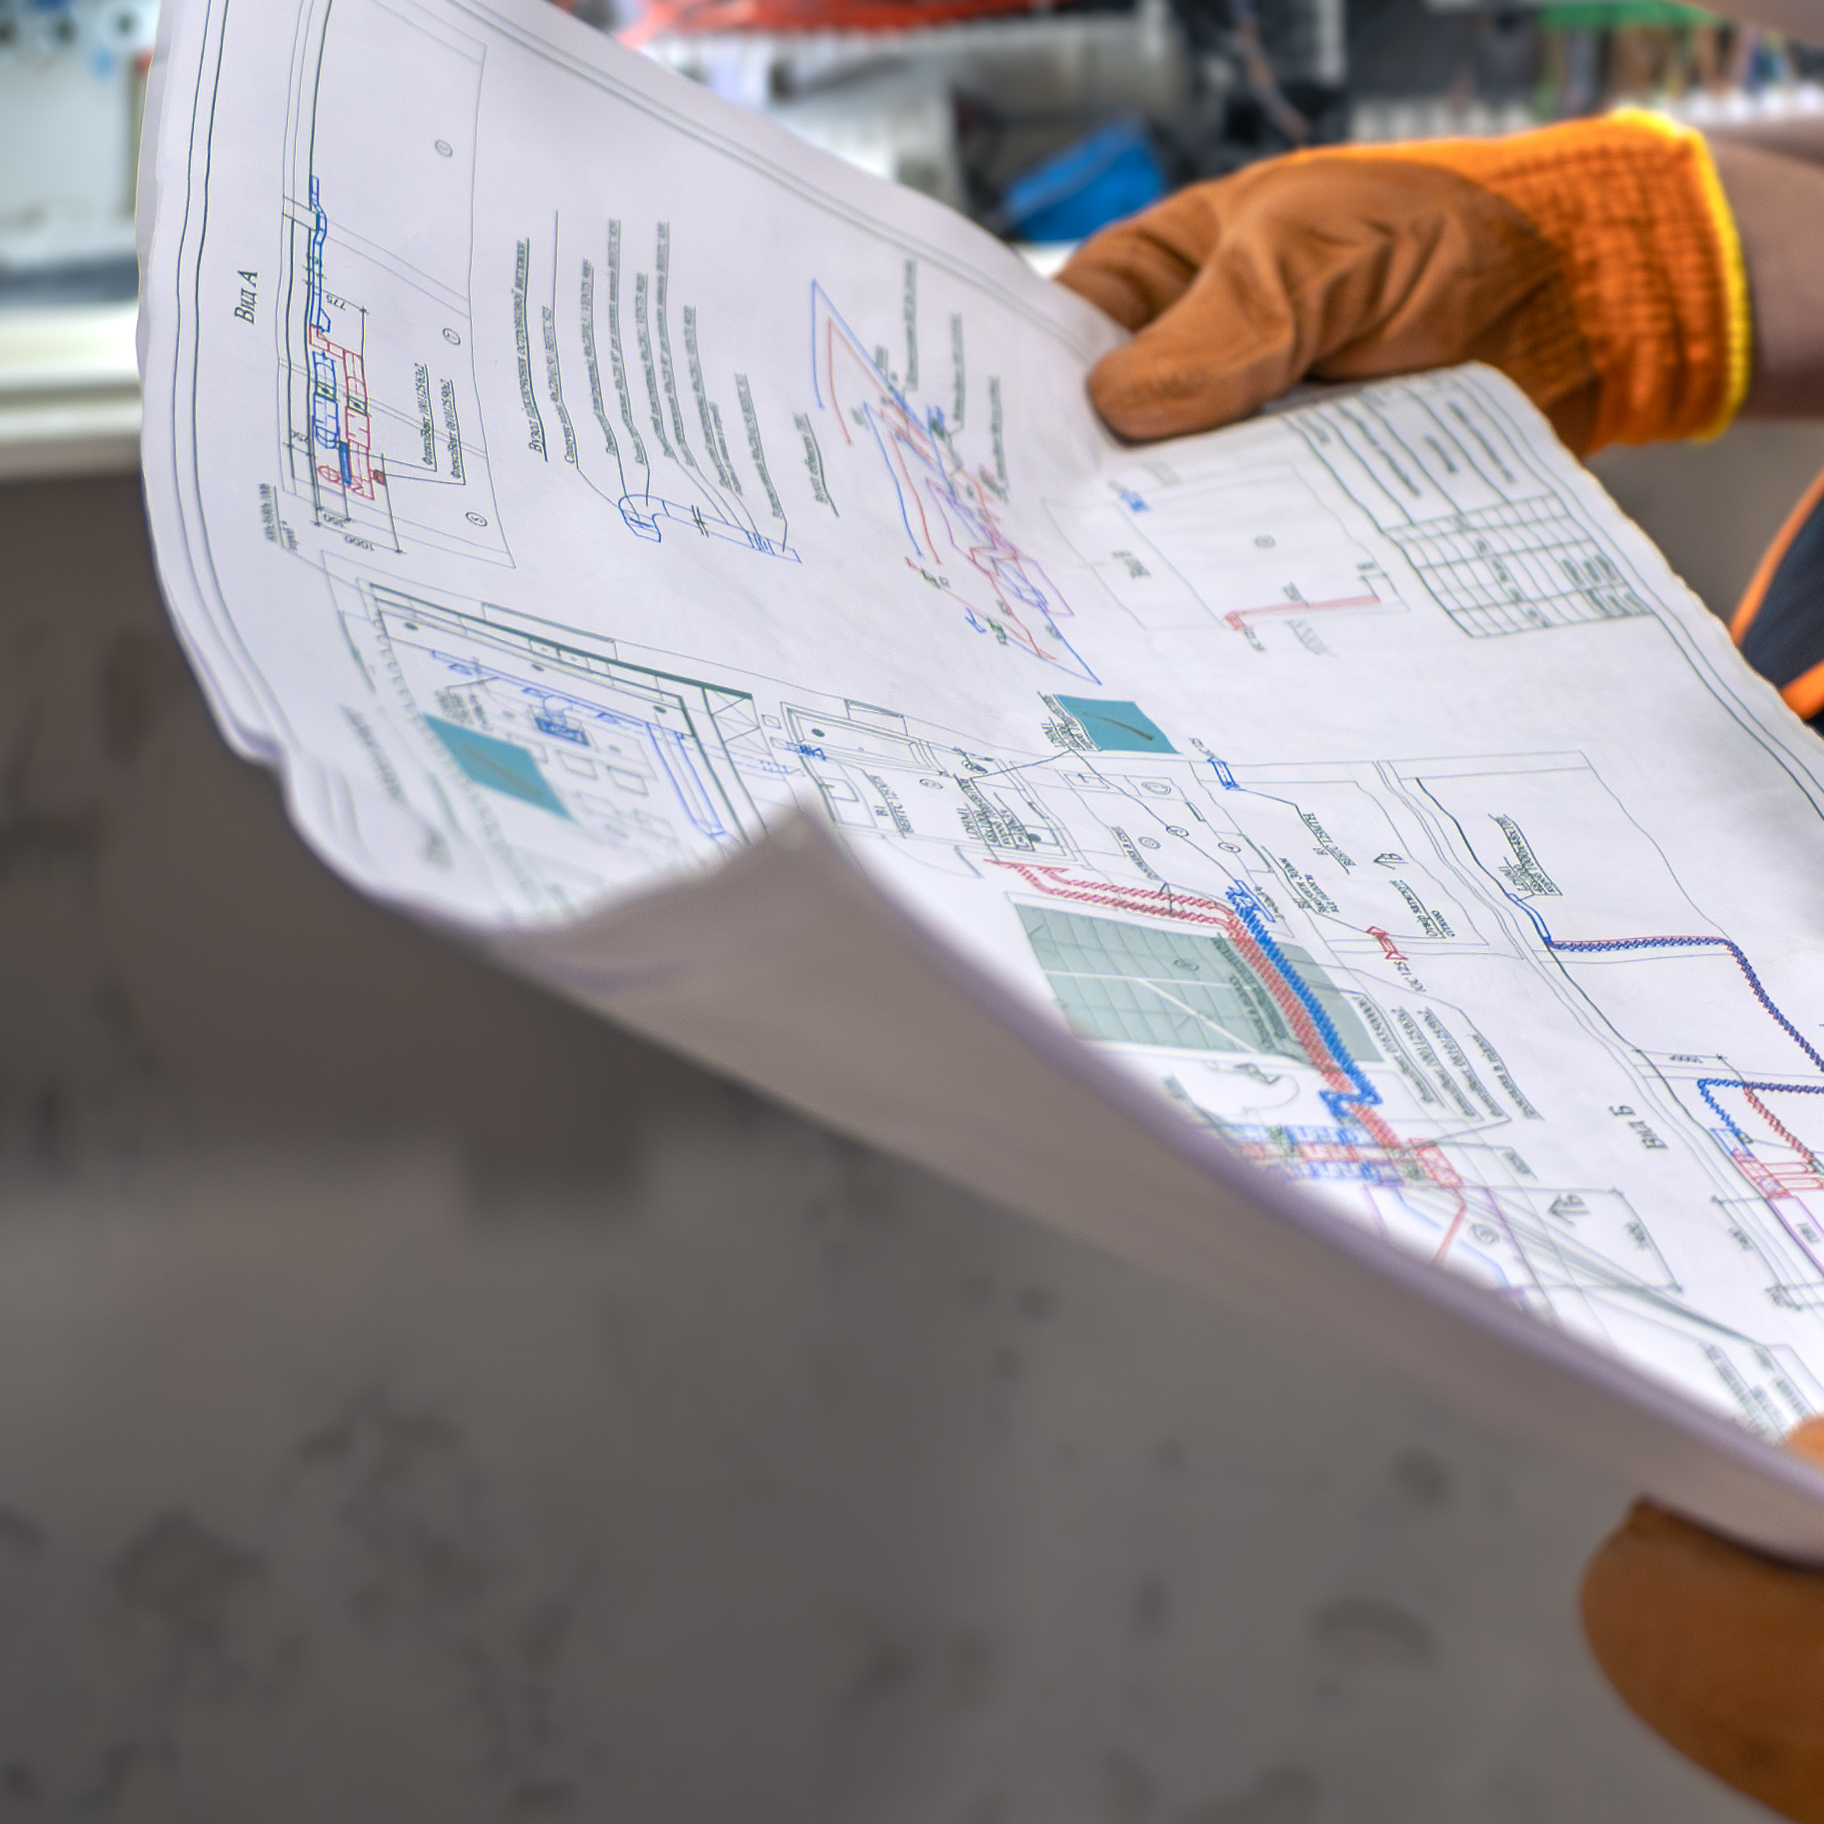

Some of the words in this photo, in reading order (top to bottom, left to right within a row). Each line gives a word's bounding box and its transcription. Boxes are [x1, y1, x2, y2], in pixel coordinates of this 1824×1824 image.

[237, 270, 258, 288] А
[234, 288, 258, 324] Вид
[326, 294, 346, 311] 775
[529, 421, 542, 452] Вузол
[1608, 1104, 1636, 1116] Б
[1628, 1121, 1668, 1149] Вид
